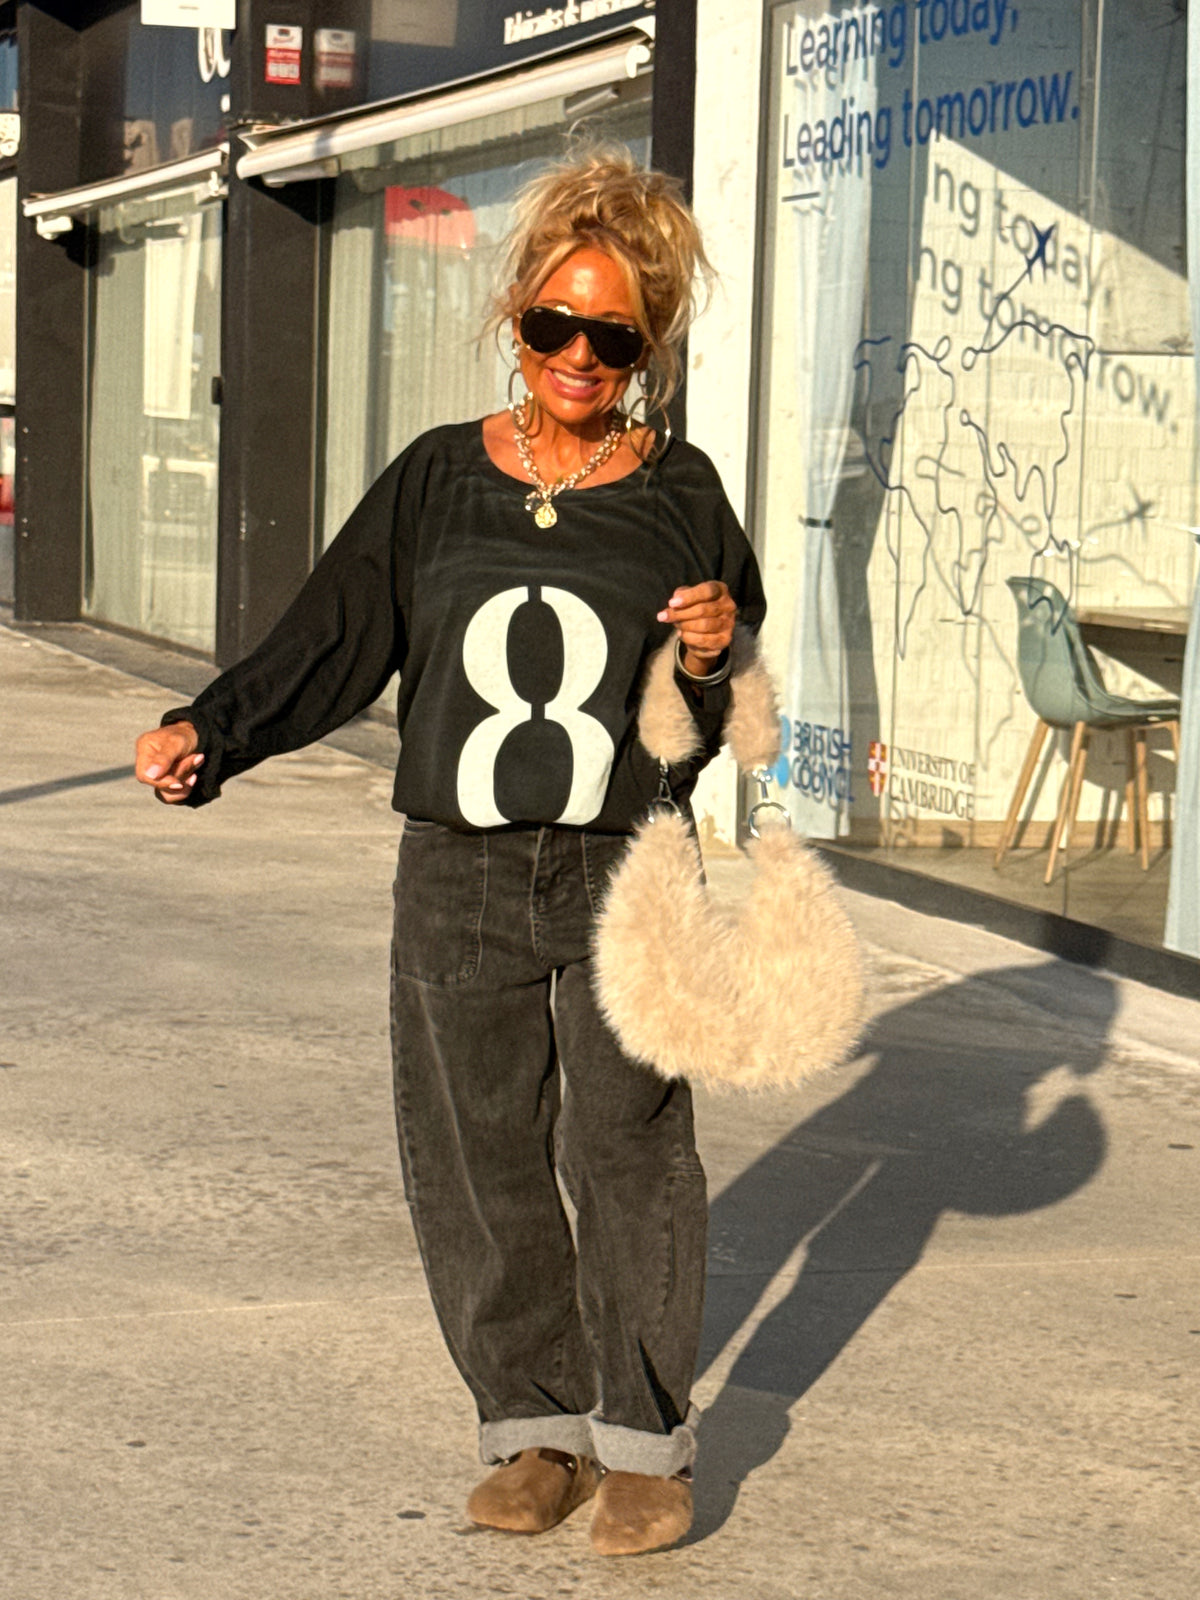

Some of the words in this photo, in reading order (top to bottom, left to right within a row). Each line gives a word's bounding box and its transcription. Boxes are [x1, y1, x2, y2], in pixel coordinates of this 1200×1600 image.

[783, 0, 907, 76] Learning
[918, 0, 1018, 46] today,
[782, 96, 892, 170] Leading
[902, 70, 1080, 148] tomorrow.
[456, 585, 615, 828] 8
[889, 773, 975, 821] CAMBRIDGE
